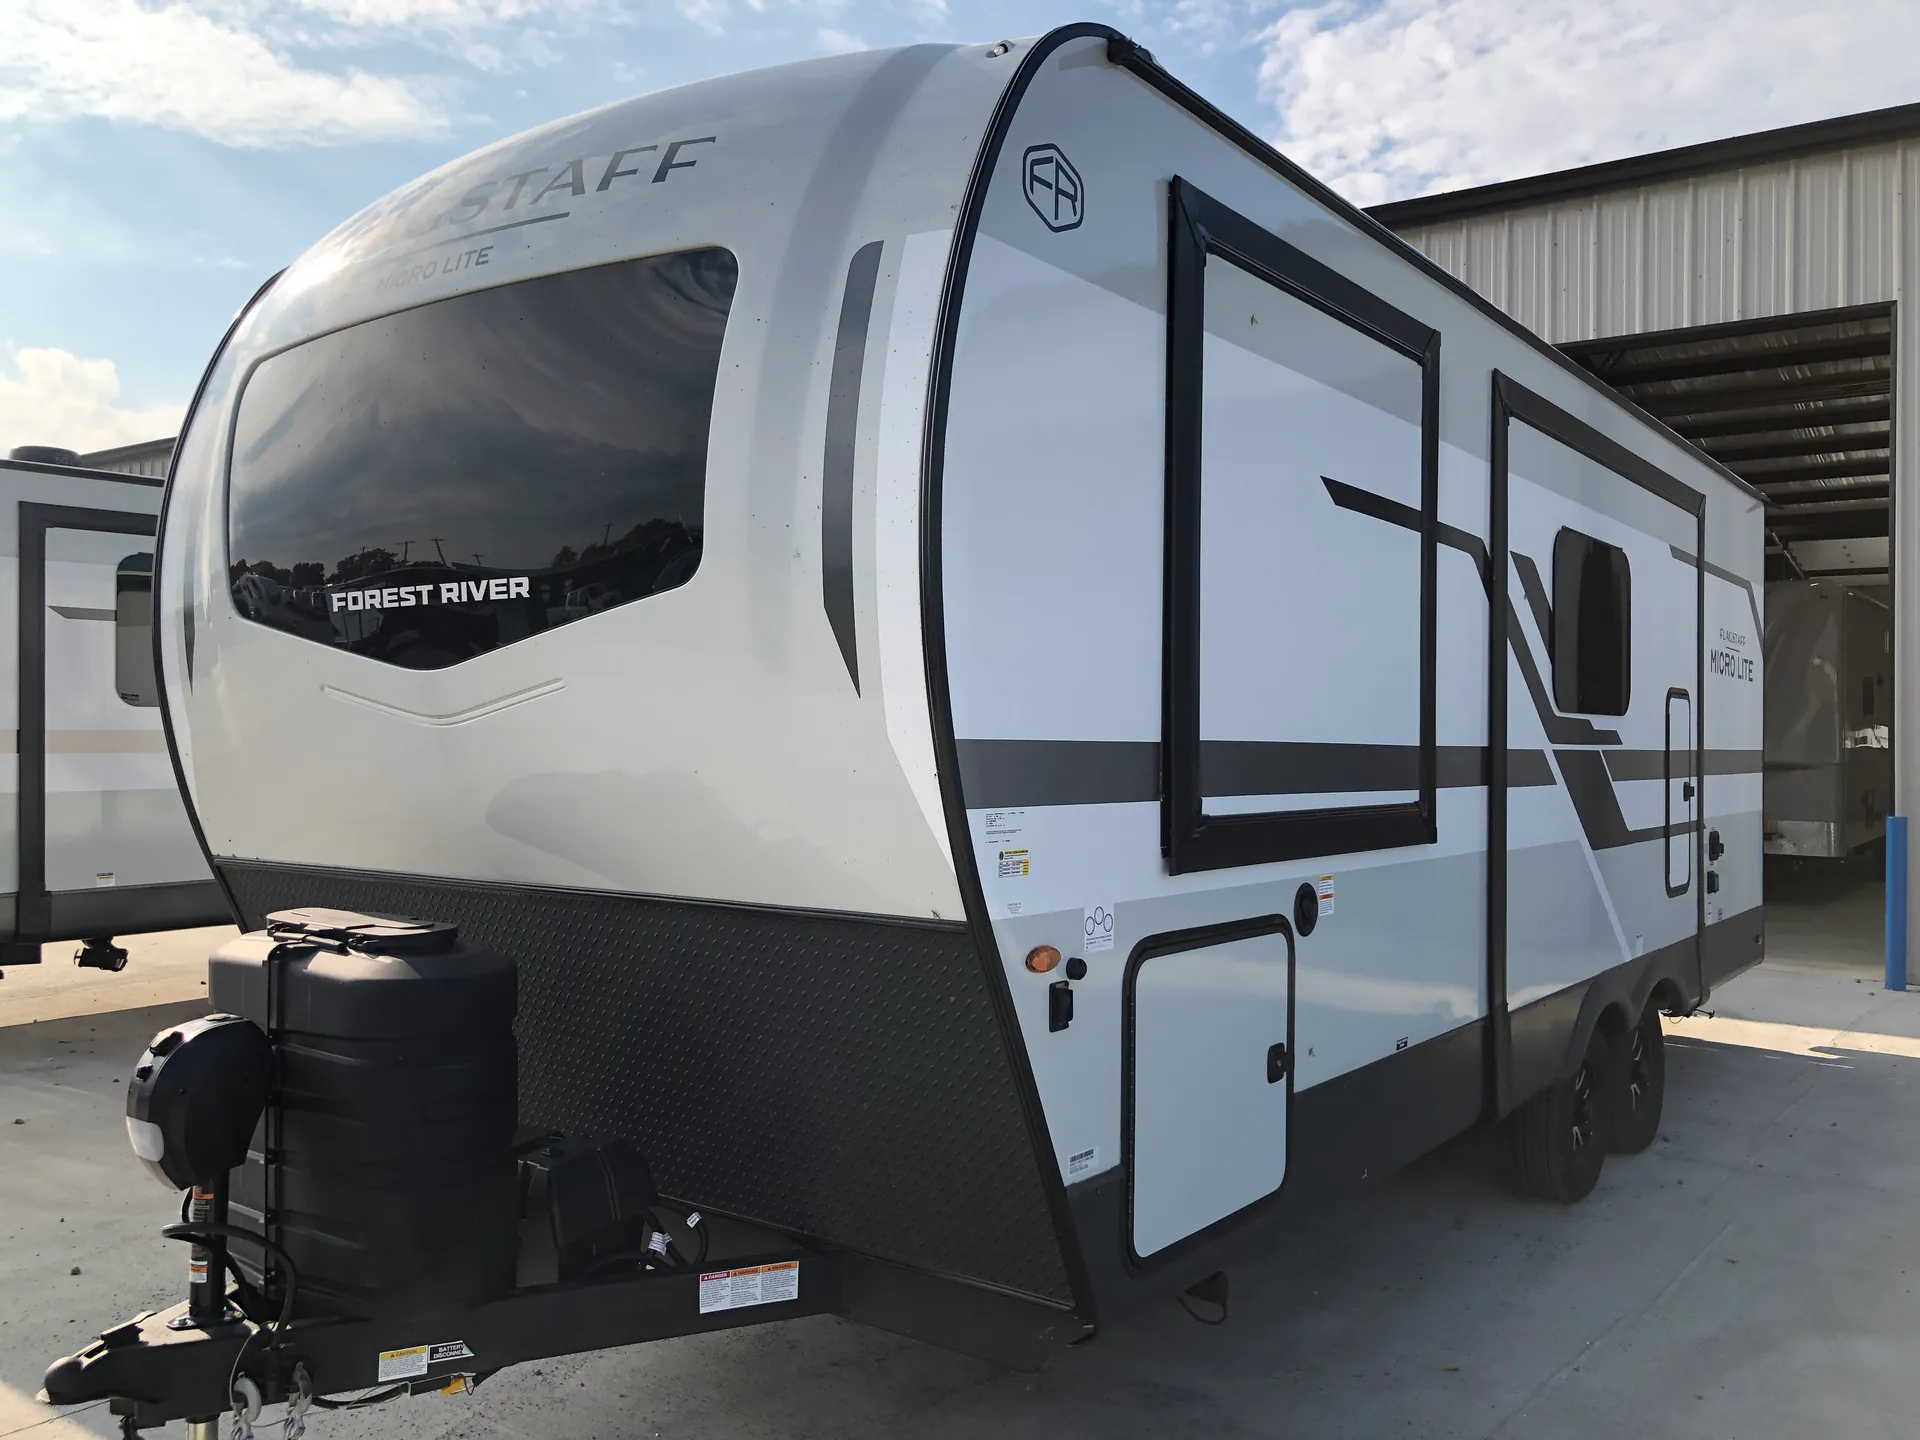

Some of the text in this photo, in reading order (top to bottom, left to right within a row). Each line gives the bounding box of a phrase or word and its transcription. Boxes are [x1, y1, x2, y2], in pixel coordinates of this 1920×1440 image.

[374, 245, 495, 294] MICRO LITE
[330, 576, 531, 613] FOREST RIVER
[1719, 628, 1746, 647] FLAGSTAFF
[1710, 648, 1754, 682] MICRO LITE
[708, 1272, 728, 1280] DANGER
[395, 1348, 418, 1357] CAUTION
[433, 1349, 463, 1359] DISCONNE
